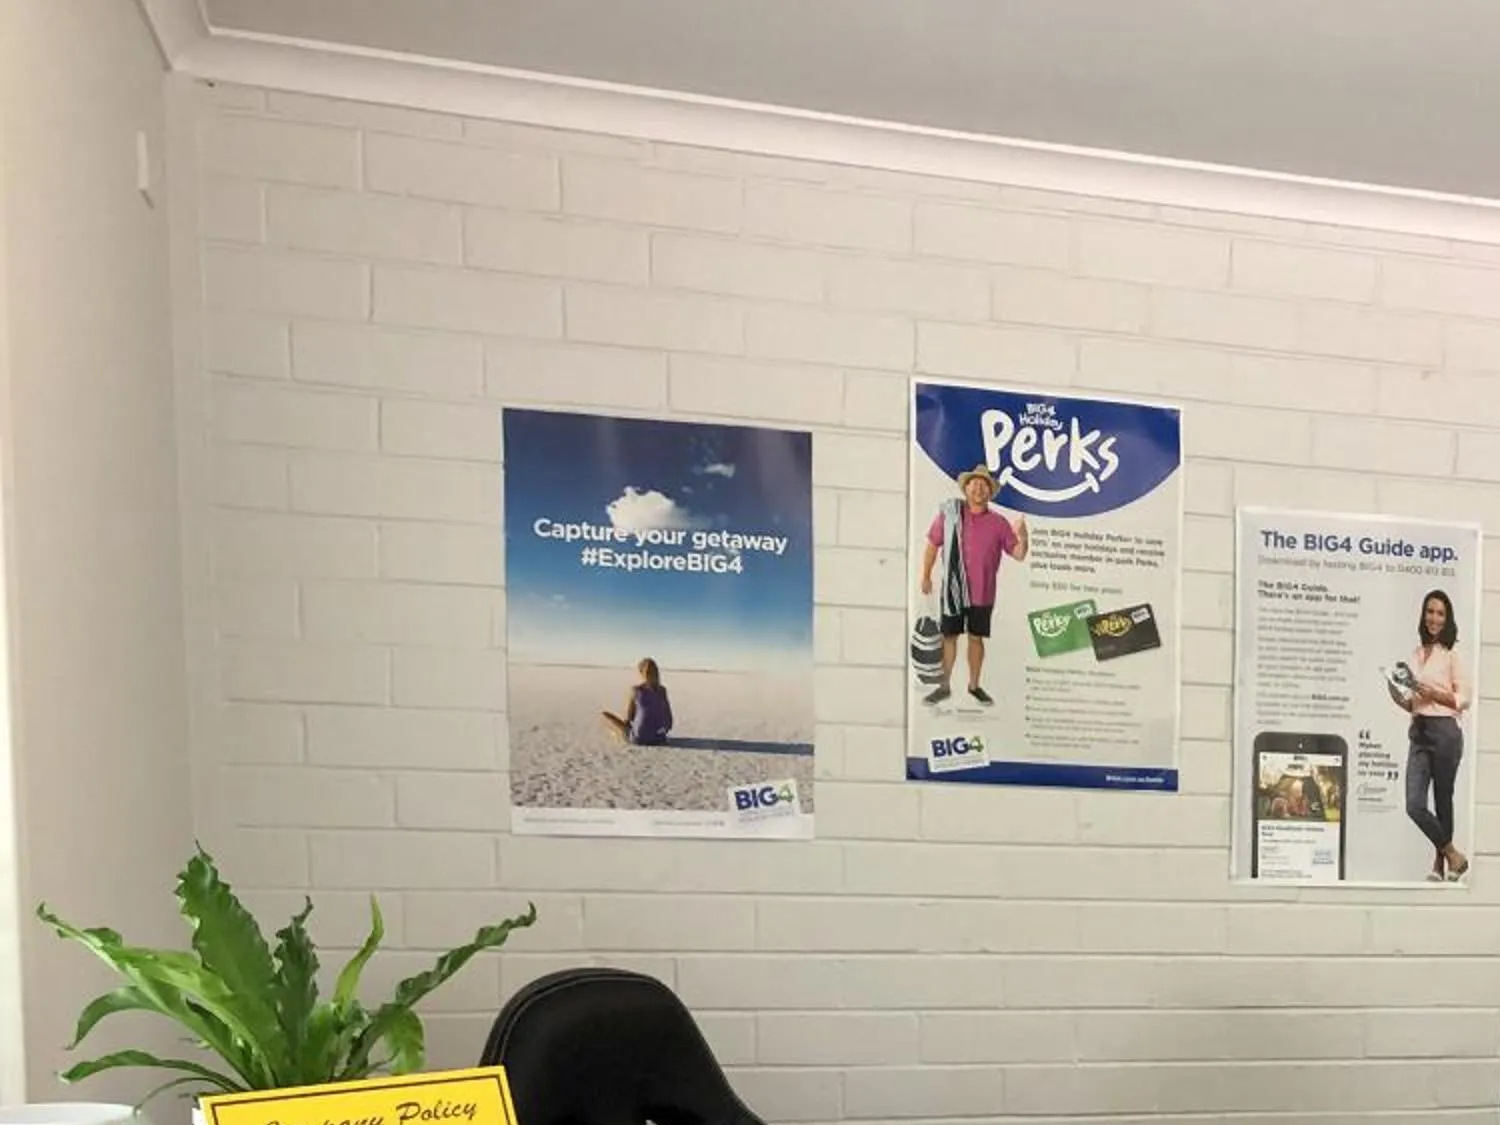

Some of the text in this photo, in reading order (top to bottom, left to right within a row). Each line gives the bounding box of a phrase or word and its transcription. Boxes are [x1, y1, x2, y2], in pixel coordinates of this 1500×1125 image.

[981, 409, 1119, 481] Perks
[533, 517, 788, 556] Capture your getaway
[1261, 530, 1459, 563] The BIG4 Guide app.
[581, 547, 743, 574] #ExploreBIG4
[1257, 580, 1274, 589] The
[1276, 581, 1299, 592] BIG4
[931, 736, 984, 758] BIG4
[733, 783, 794, 811] BIG4
